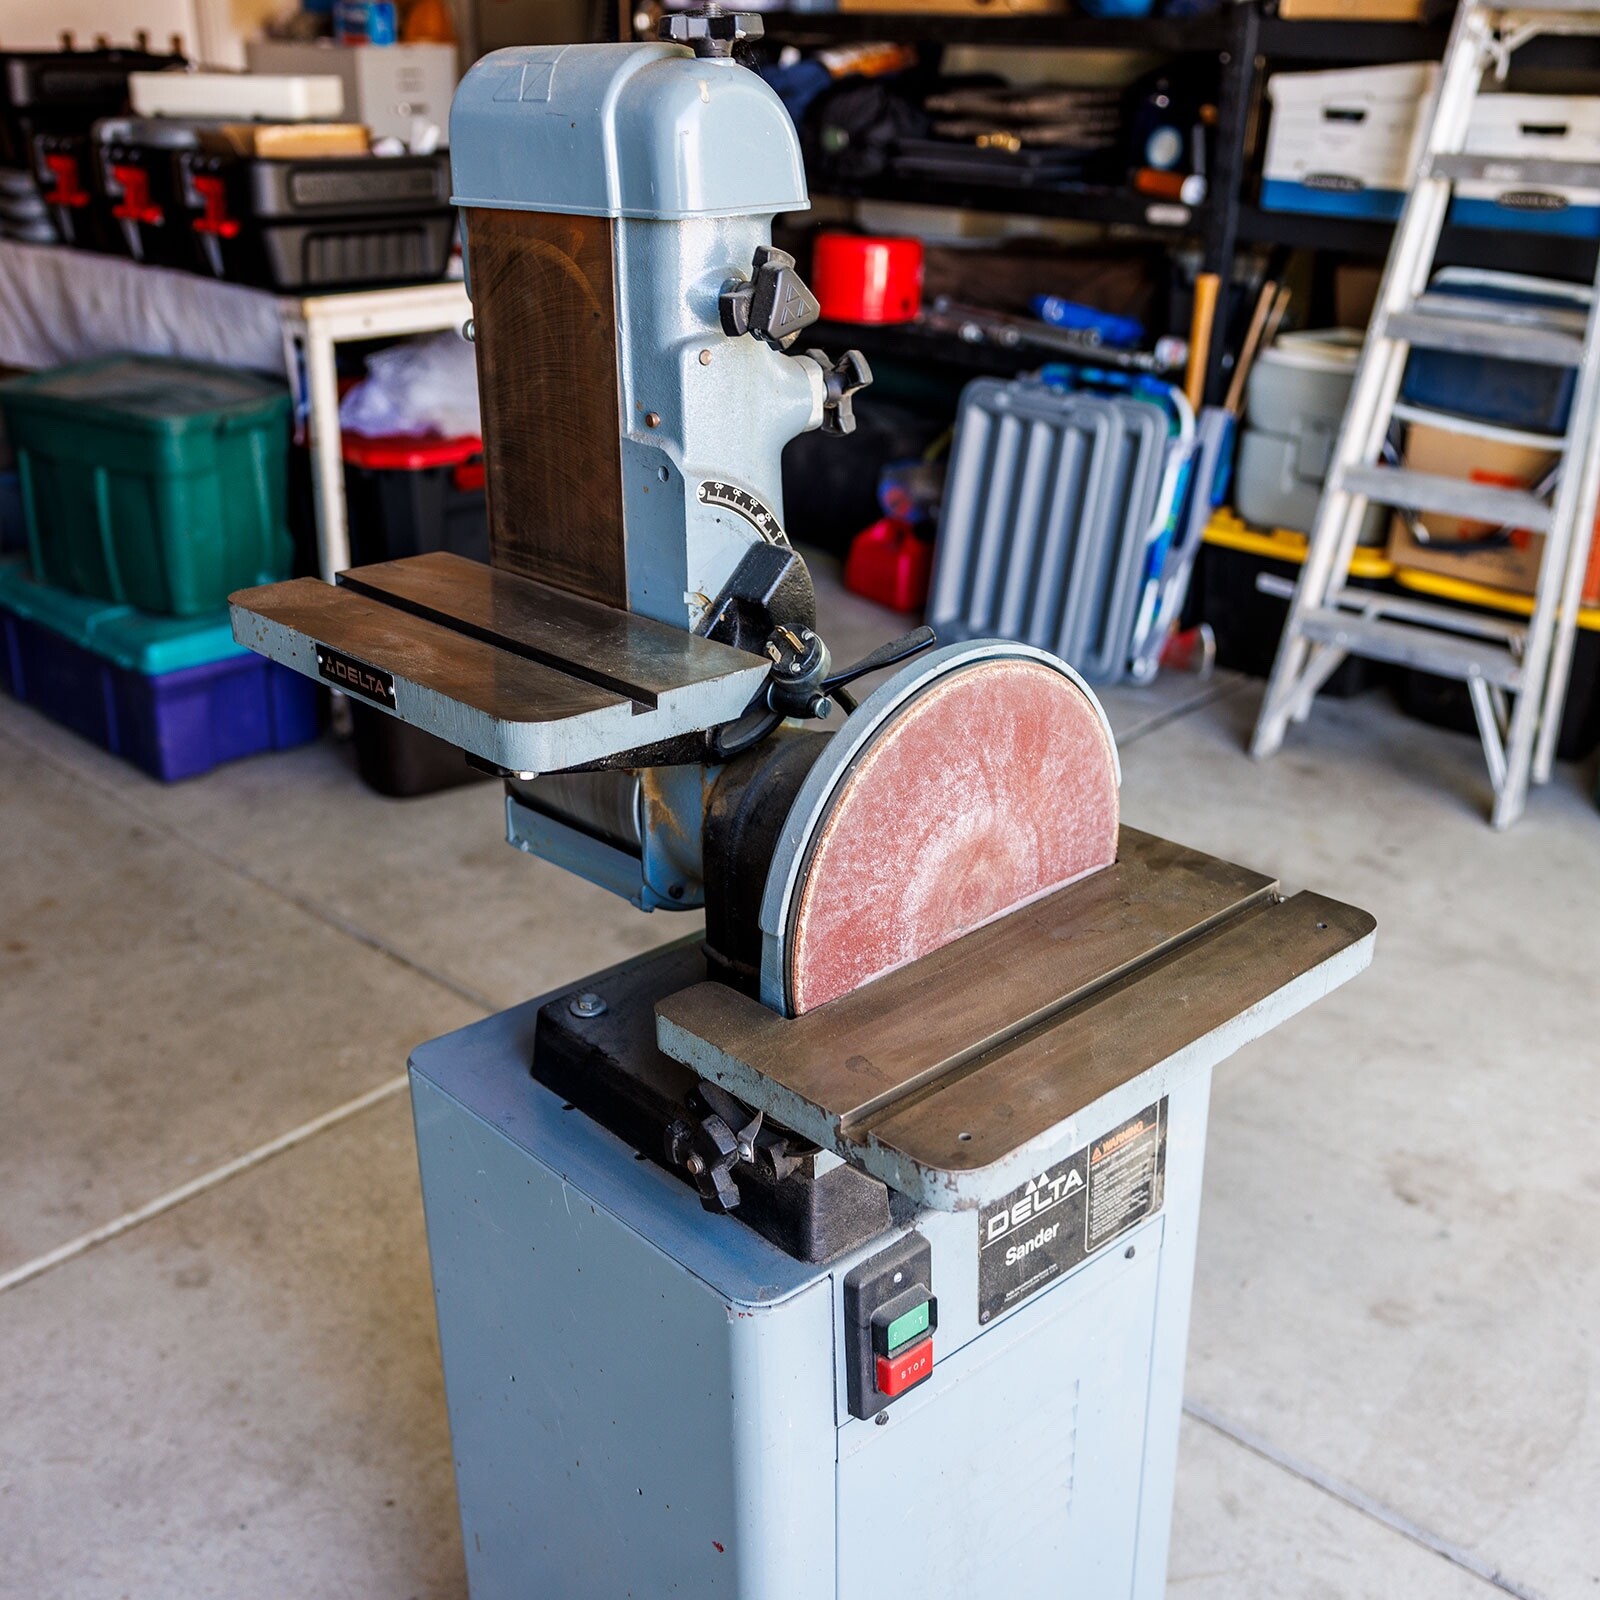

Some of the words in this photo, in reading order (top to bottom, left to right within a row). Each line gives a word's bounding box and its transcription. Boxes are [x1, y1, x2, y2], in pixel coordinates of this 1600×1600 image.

[714, 482, 724, 490] 40
[733, 488, 742, 497] 30
[750, 498, 758, 507] 20
[336, 661, 386, 697] DELTA
[1103, 1120, 1143, 1153] WARNING
[988, 1168, 1083, 1241] DELTA
[1005, 1222, 1060, 1266] Sander
[901, 1358, 926, 1379] STOP
